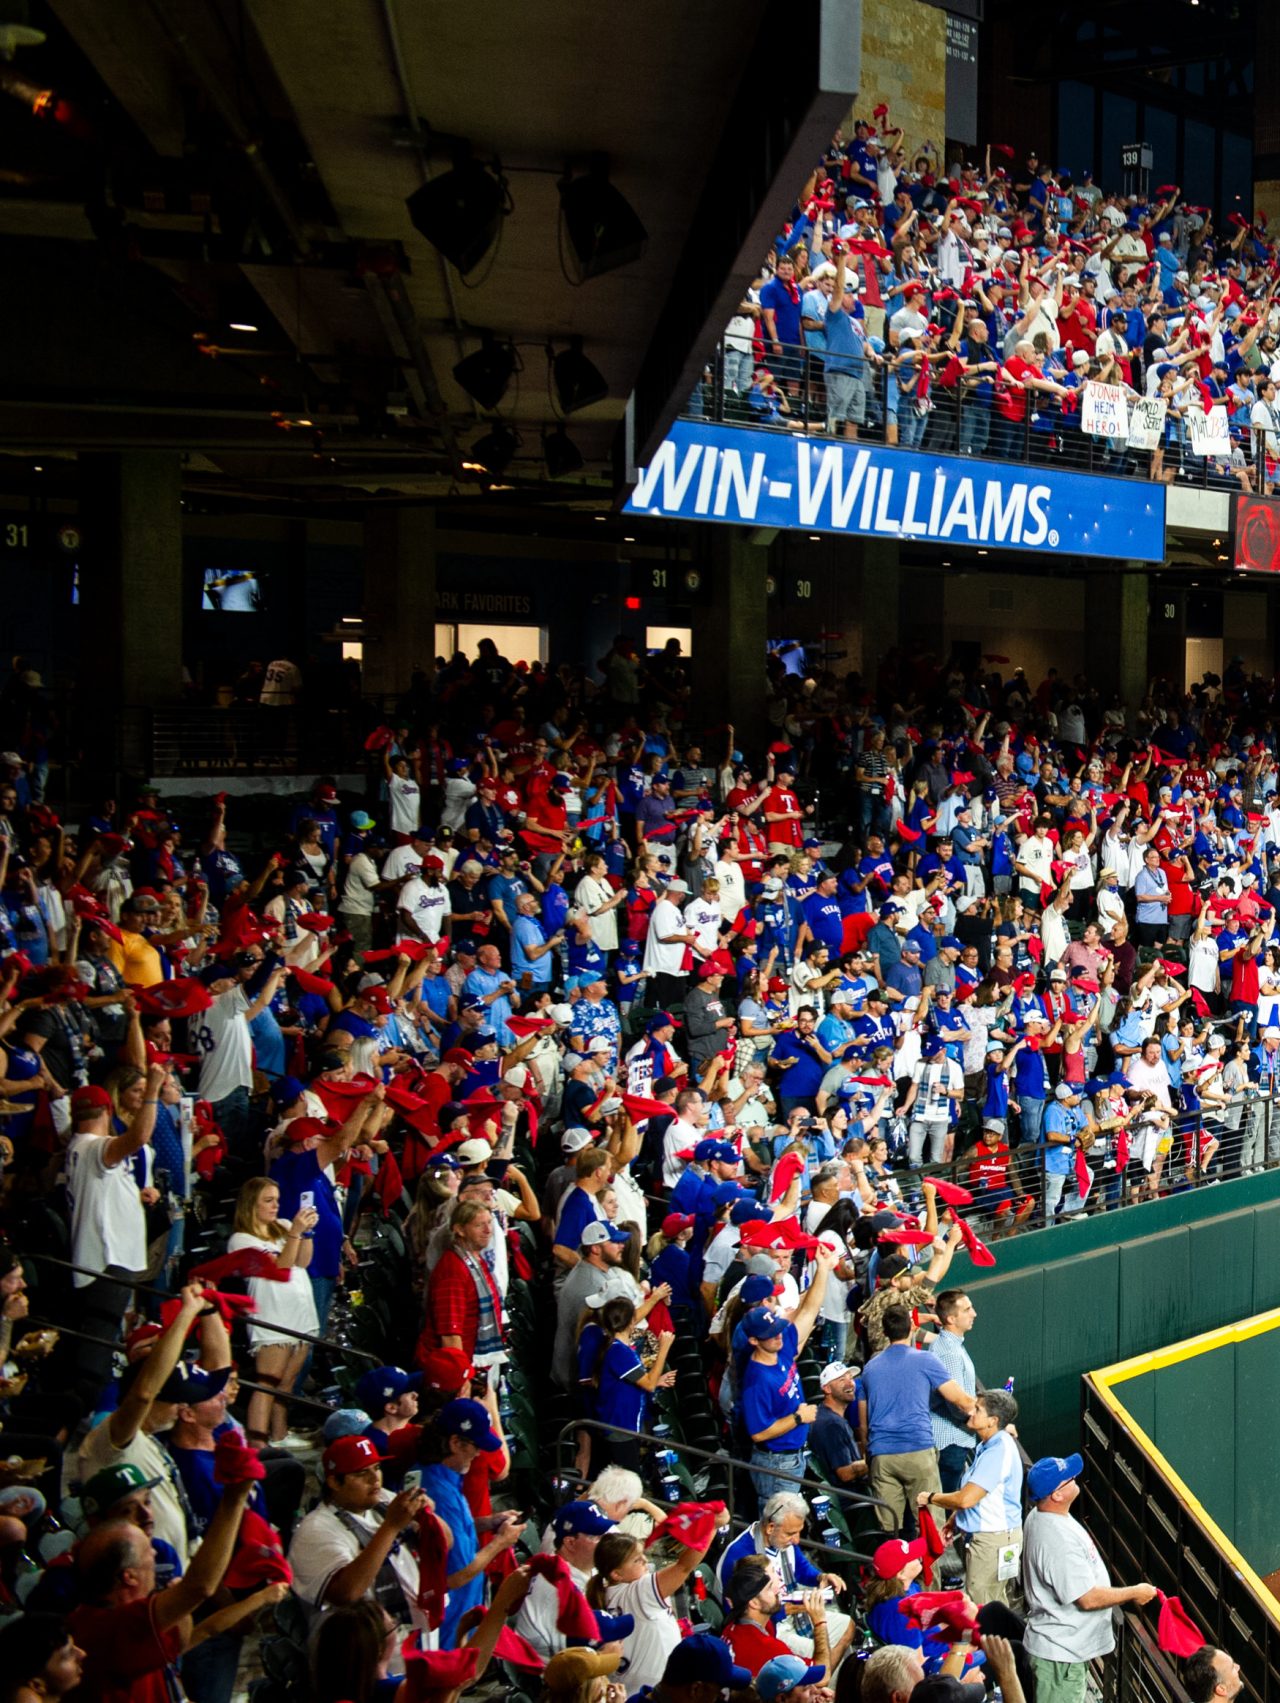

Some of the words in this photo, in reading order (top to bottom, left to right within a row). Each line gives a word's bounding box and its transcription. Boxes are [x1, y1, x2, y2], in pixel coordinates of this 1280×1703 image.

[1123, 152, 1138, 166] 139
[1090, 383, 1120, 402] JONAH
[1094, 401, 1116, 415] HEIM
[1086, 419, 1121, 435] HERO!
[8, 524, 28, 548] 31
[652, 570, 667, 588] 31
[797, 581, 811, 599] 30
[464, 592, 530, 614] FAVORITES
[1164, 603, 1175, 619] 30
[780, 794, 795, 813] T
[762, 1312, 774, 1324] T
[356, 1439, 373, 1455] T
[116, 1467, 138, 1486] T
[588, 1503, 602, 1517] T
